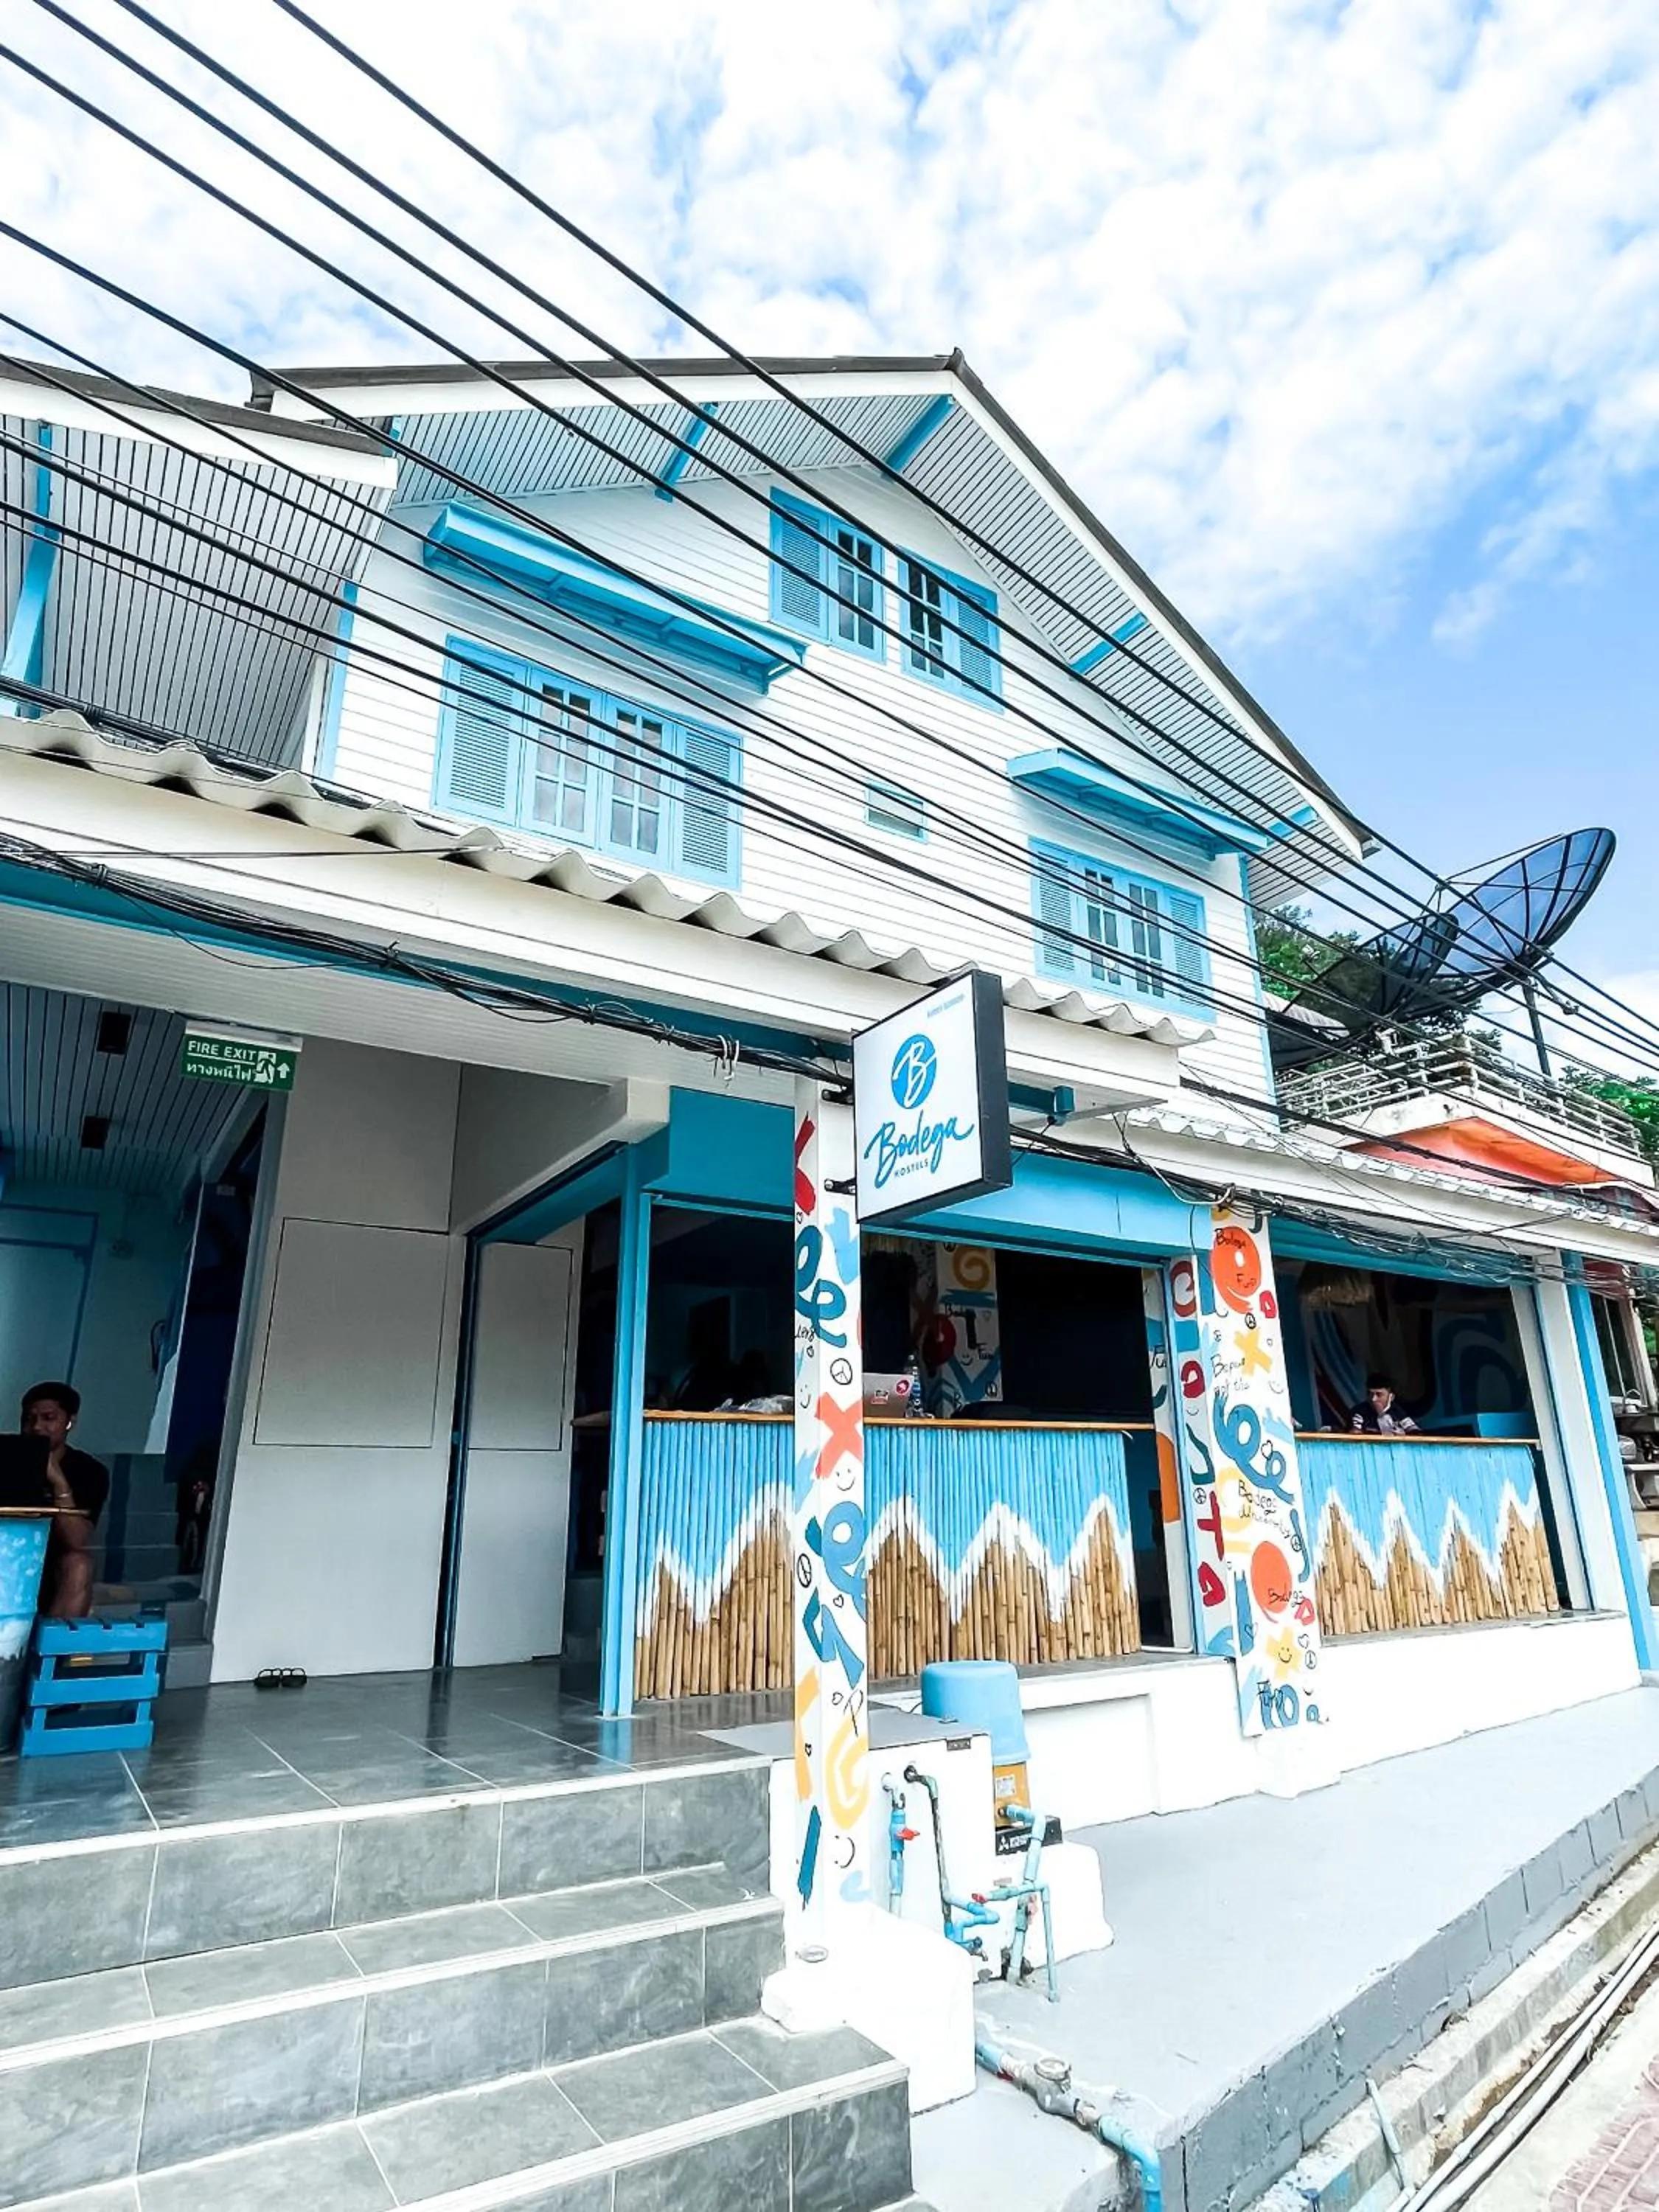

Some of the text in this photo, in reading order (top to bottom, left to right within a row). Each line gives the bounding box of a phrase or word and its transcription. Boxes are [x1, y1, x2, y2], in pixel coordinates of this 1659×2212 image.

[187, 1040, 257, 1061] FIRE EXIT
[187, 1062, 253, 1081] ทางหนีไฟ
[863, 1109, 975, 1189] Bodega
[893, 1158, 930, 1178] HOSTELS
